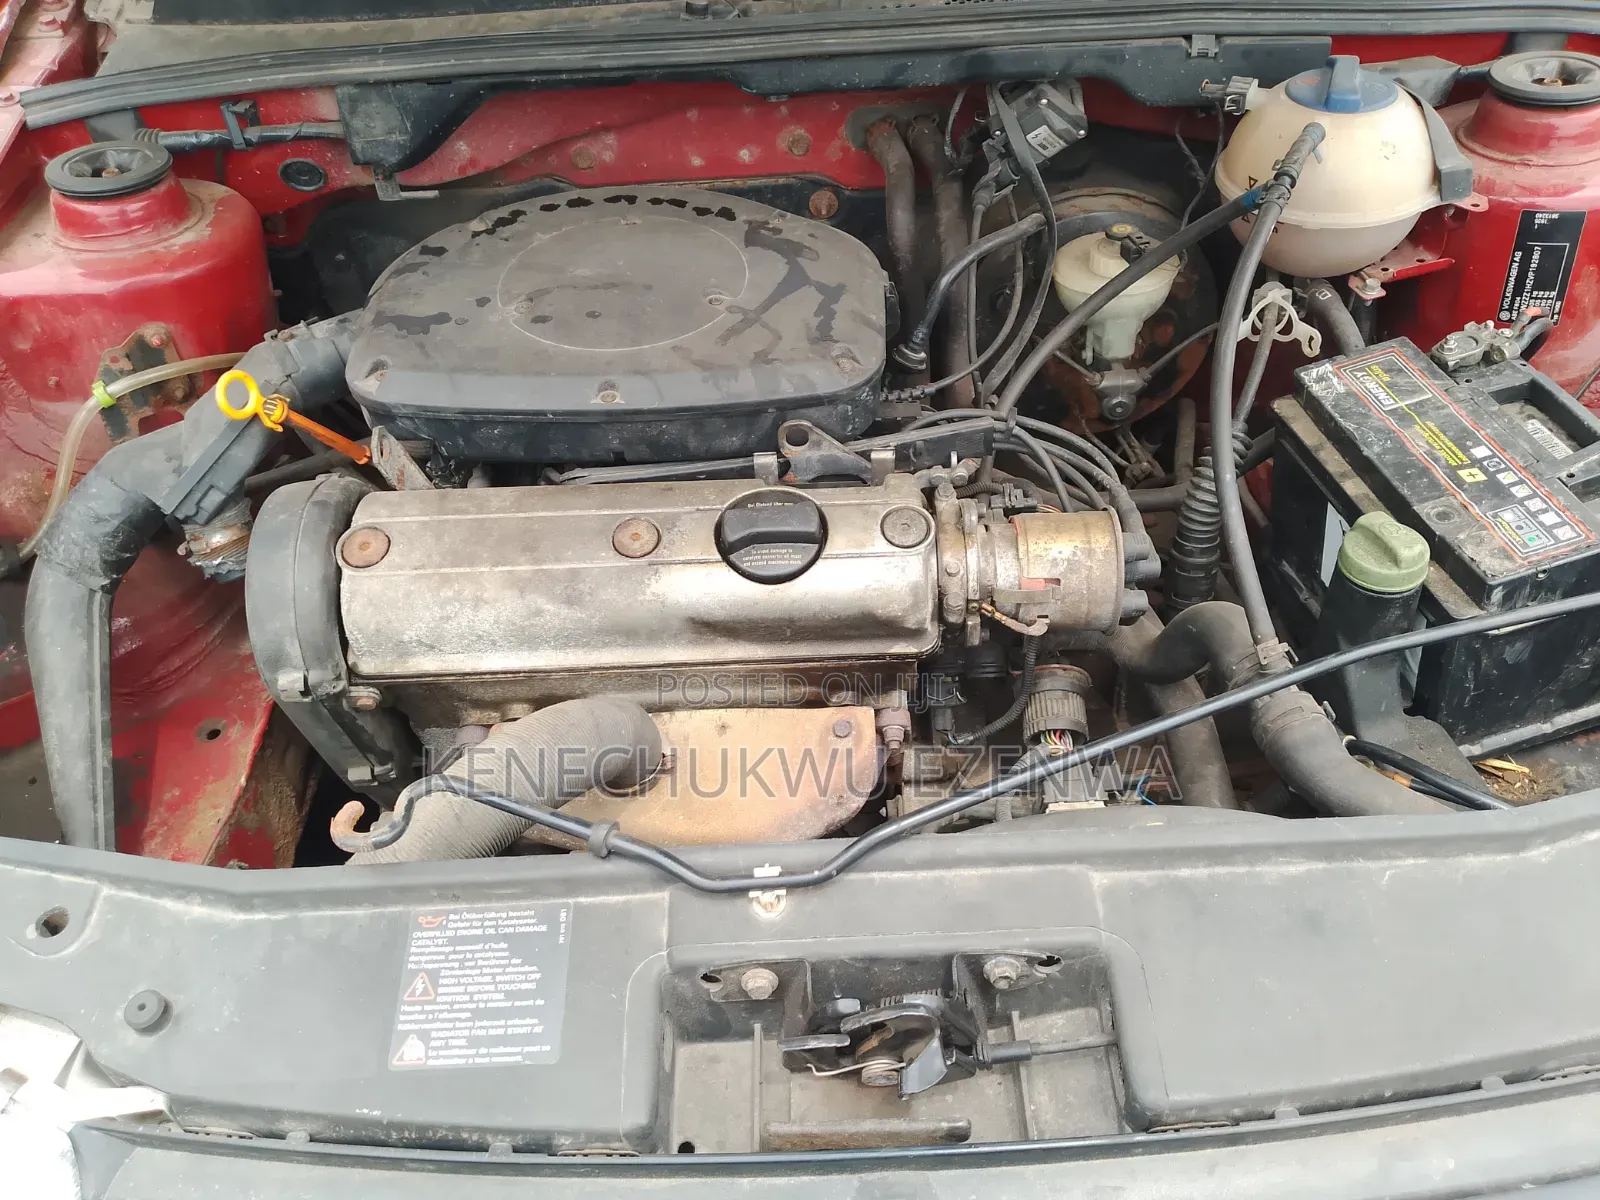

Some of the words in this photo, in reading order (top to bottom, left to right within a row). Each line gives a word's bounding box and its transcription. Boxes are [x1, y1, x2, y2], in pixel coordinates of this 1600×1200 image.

[1502, 262, 1519, 309] VOLKSWAGEN
[1514, 251, 1522, 262] AG
[1520, 246, 1542, 311] WZZZ1HZVP192807
[1353, 372, 1396, 404] ENERGY
[412, 930, 456, 938] OVERFILLED
